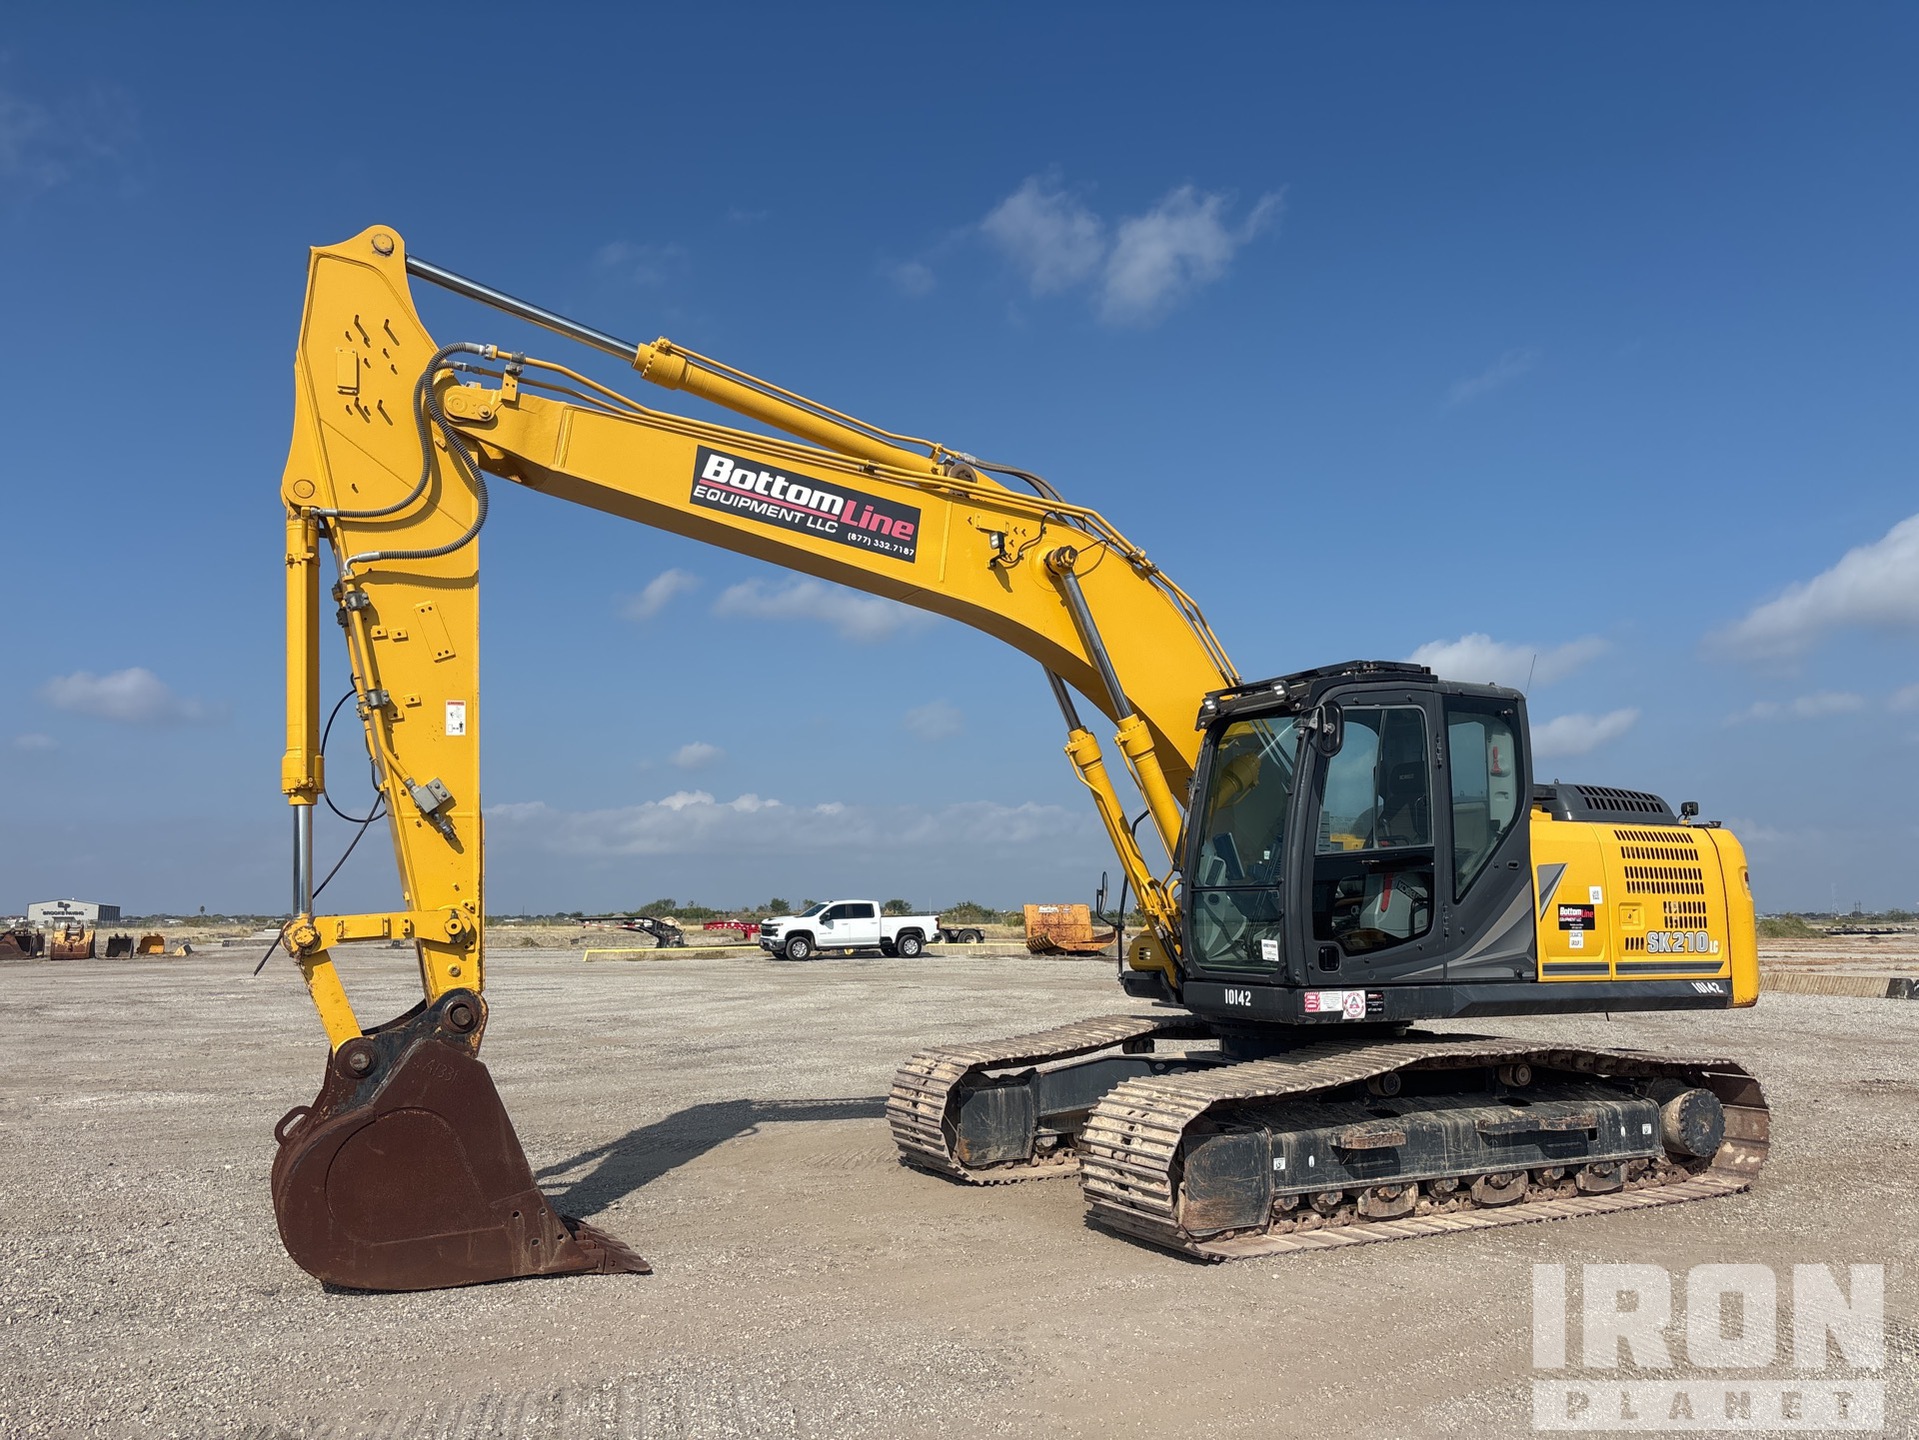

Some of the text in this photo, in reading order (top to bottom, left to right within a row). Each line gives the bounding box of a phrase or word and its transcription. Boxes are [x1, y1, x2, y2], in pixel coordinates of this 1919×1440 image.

[693, 485, 839, 533] EQUIPMENT LLC
[847, 532, 915, 556] (877) 332.7187
[1224, 988, 1252, 1006] 10142
